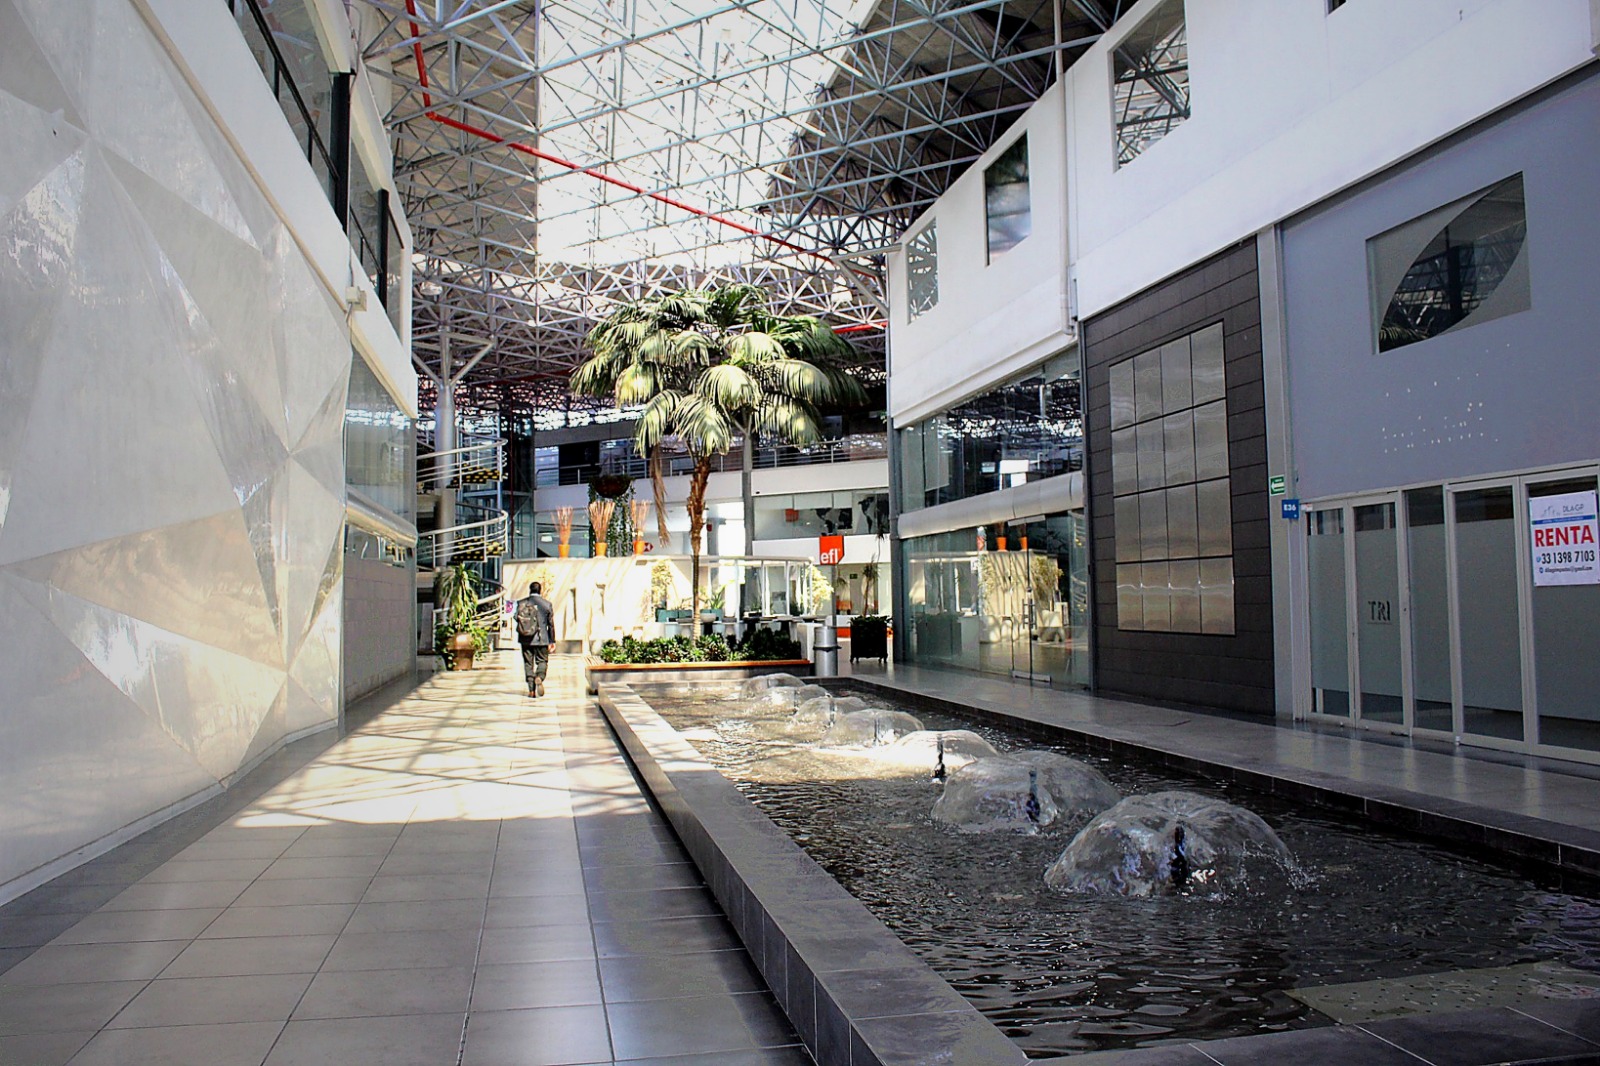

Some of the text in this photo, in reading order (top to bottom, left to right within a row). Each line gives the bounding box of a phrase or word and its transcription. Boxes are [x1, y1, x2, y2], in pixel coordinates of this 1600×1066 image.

[1535, 525, 1594, 547] RENTA
[820, 548, 839, 564] efl
[1541, 550, 1595, 565] 33 1398 7103
[1368, 600, 1391, 621] TRI
